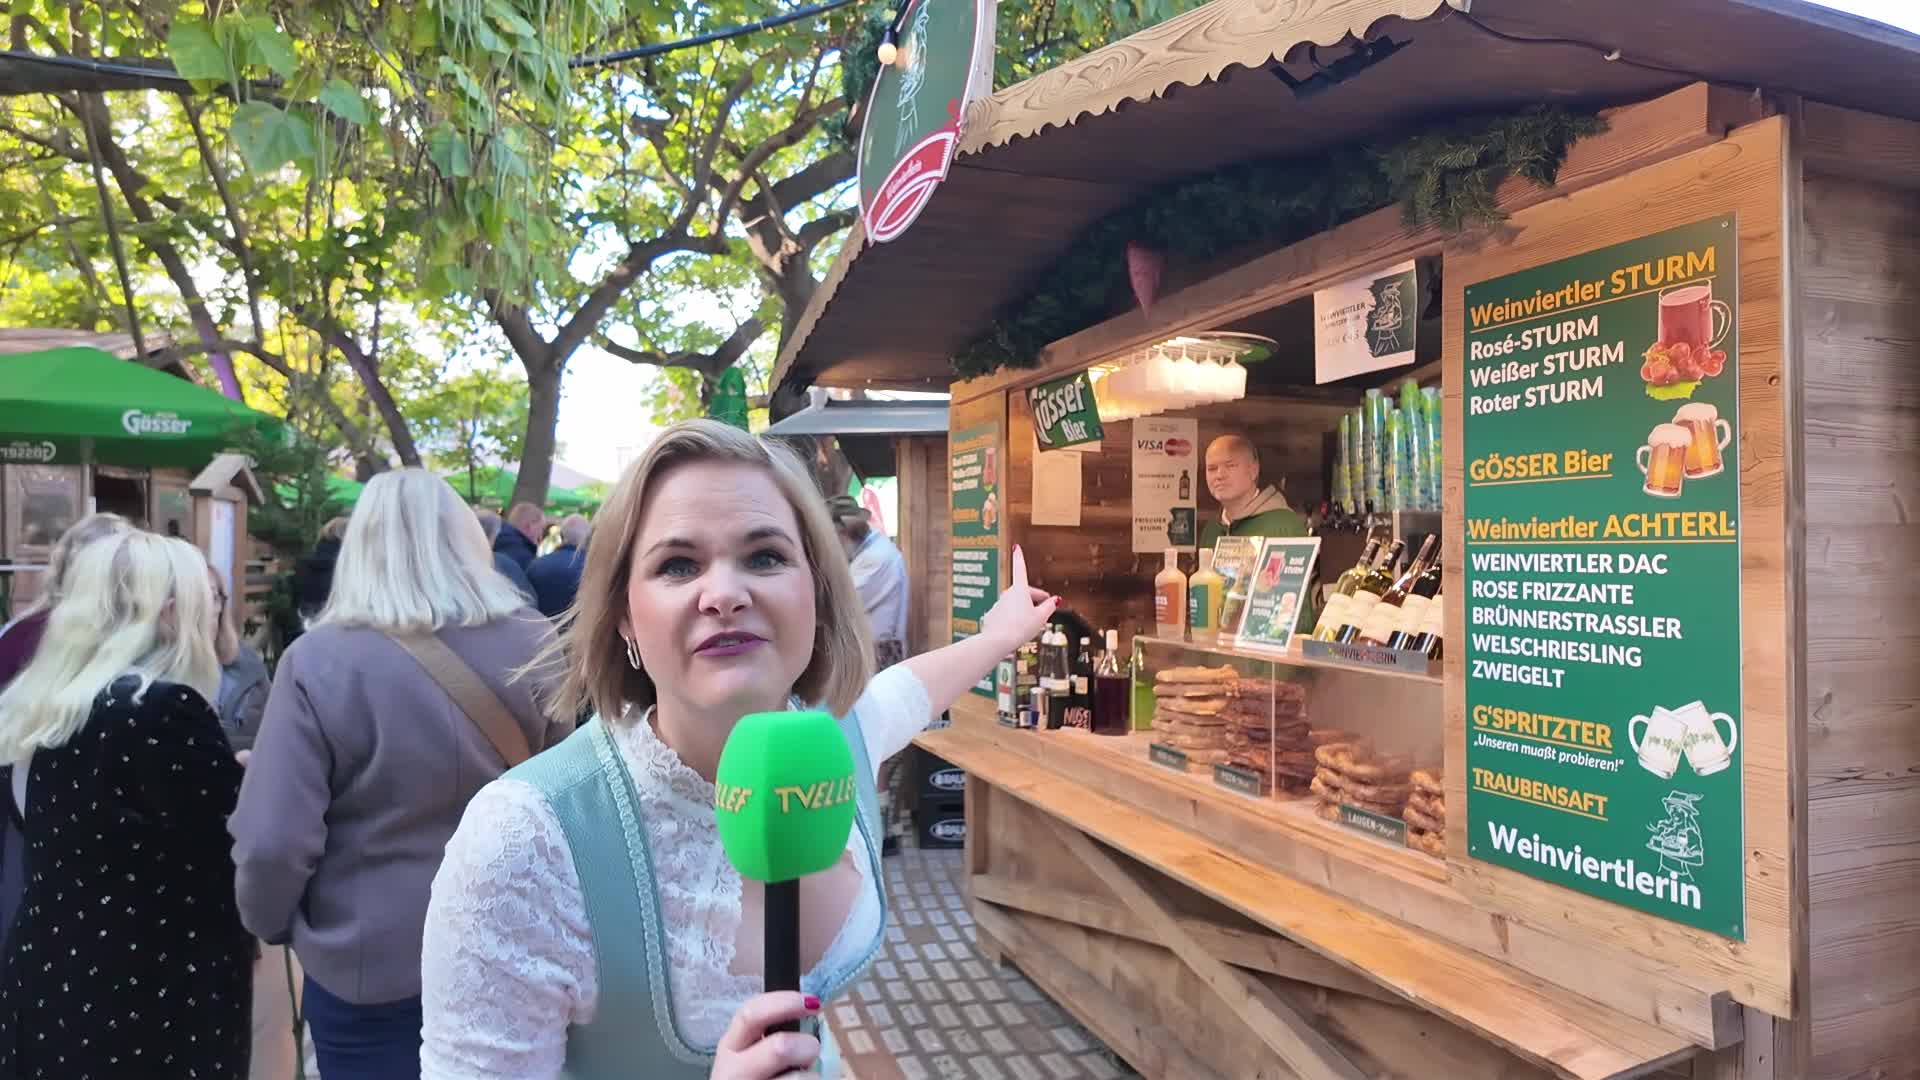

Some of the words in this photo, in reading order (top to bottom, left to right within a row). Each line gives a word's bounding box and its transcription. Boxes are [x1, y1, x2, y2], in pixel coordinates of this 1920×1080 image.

[1469, 280, 1605, 327] Weinviertler
[1610, 246, 1716, 294] STURM
[1470, 315, 1600, 361] Rosé-STURM
[1470, 361, 1540, 388] Weißer
[1543, 341, 1625, 376] STURM
[1470, 391, 1521, 416] Roter
[1524, 376, 1604, 408] STURM
[1061, 419, 1089, 442] Bier
[1136, 439, 1164, 450] VISA
[1470, 452, 1558, 481] GÖSSER
[1564, 449, 1613, 474] Bier
[1468, 515, 1598, 540] Weinviertler
[1603, 511, 1736, 538] ACHTERL
[1472, 553, 1613, 573] WEINVIERTLER
[1619, 554, 1668, 574] DAC
[1472, 580, 1518, 600] ROSE
[1522, 582, 1635, 605] FRIZZANTE
[1472, 604, 1683, 639] BRÜNNERSTRASSLER
[1472, 633, 1642, 667] WELSCHRIESLING
[1472, 660, 1565, 688] ZWEIGELT
[1521, 743, 1556, 762] muaßt
[1472, 767, 1608, 817] TRAUBENSAFT
[1487, 820, 1702, 910] Weinviertlerin
